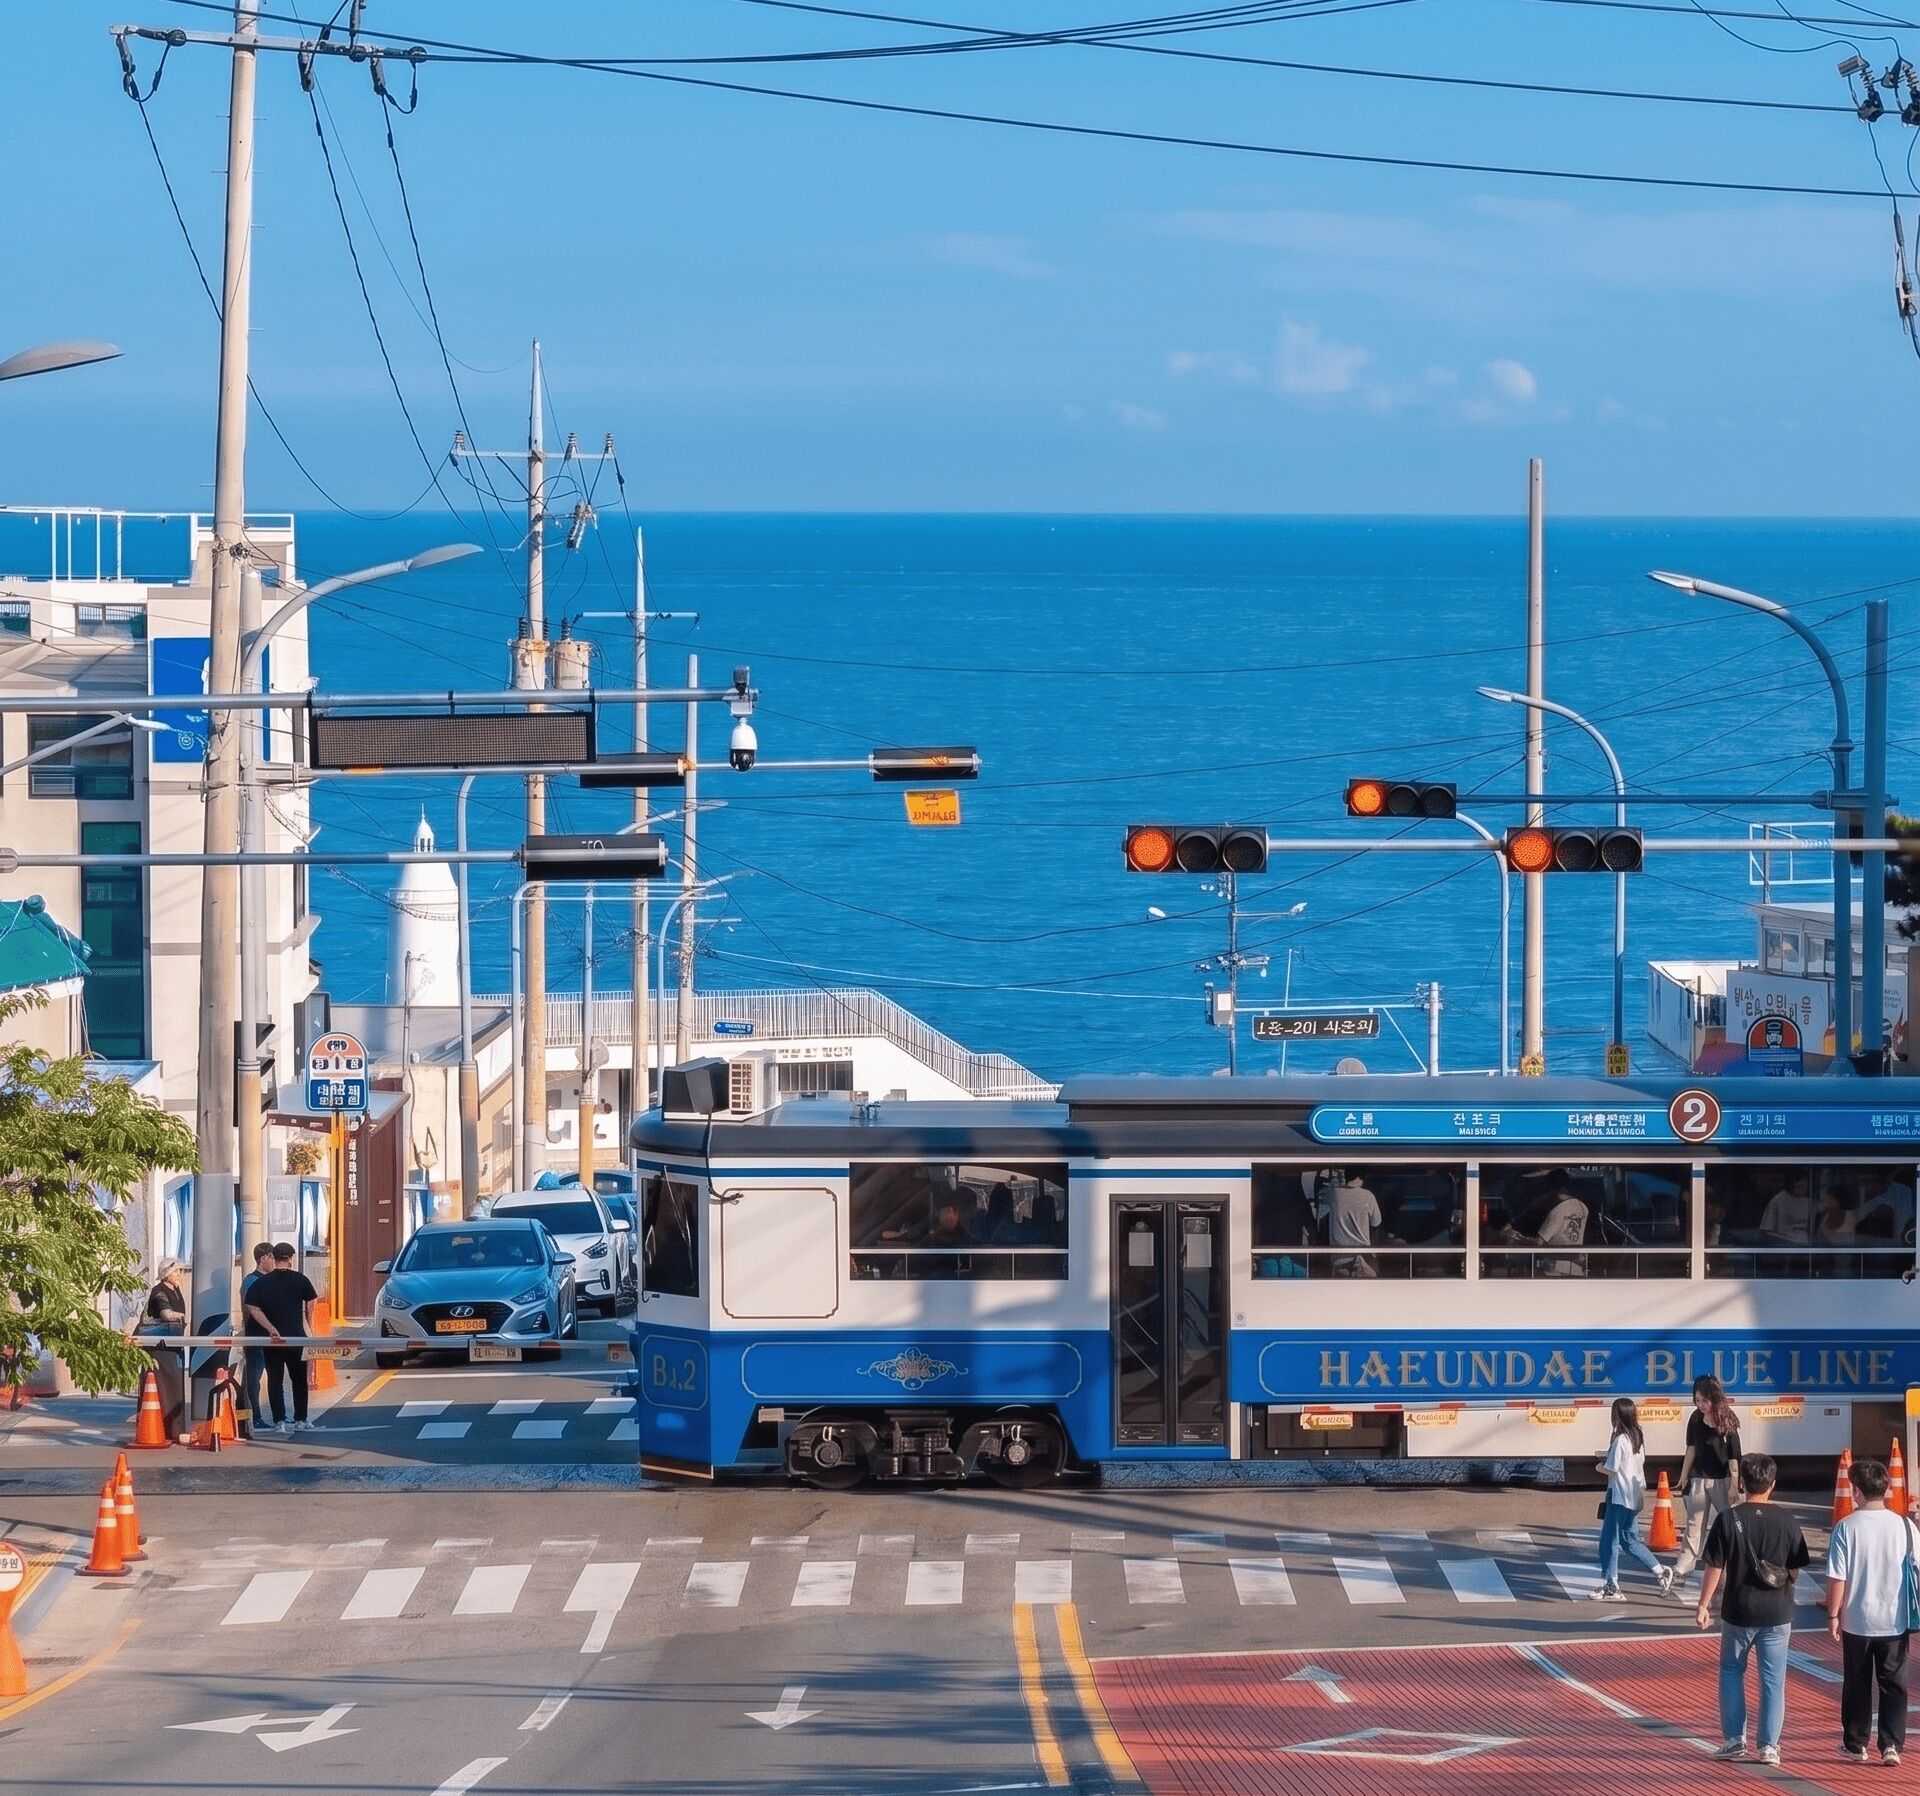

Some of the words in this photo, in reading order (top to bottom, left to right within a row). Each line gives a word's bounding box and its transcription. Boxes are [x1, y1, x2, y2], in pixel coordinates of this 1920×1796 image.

[1683, 1098, 1708, 1133] 2
[1318, 1350, 1614, 1388] HAEUNDAE
[1645, 1350, 1775, 1387] BLUE
[1789, 1350, 1897, 1386] LINE
